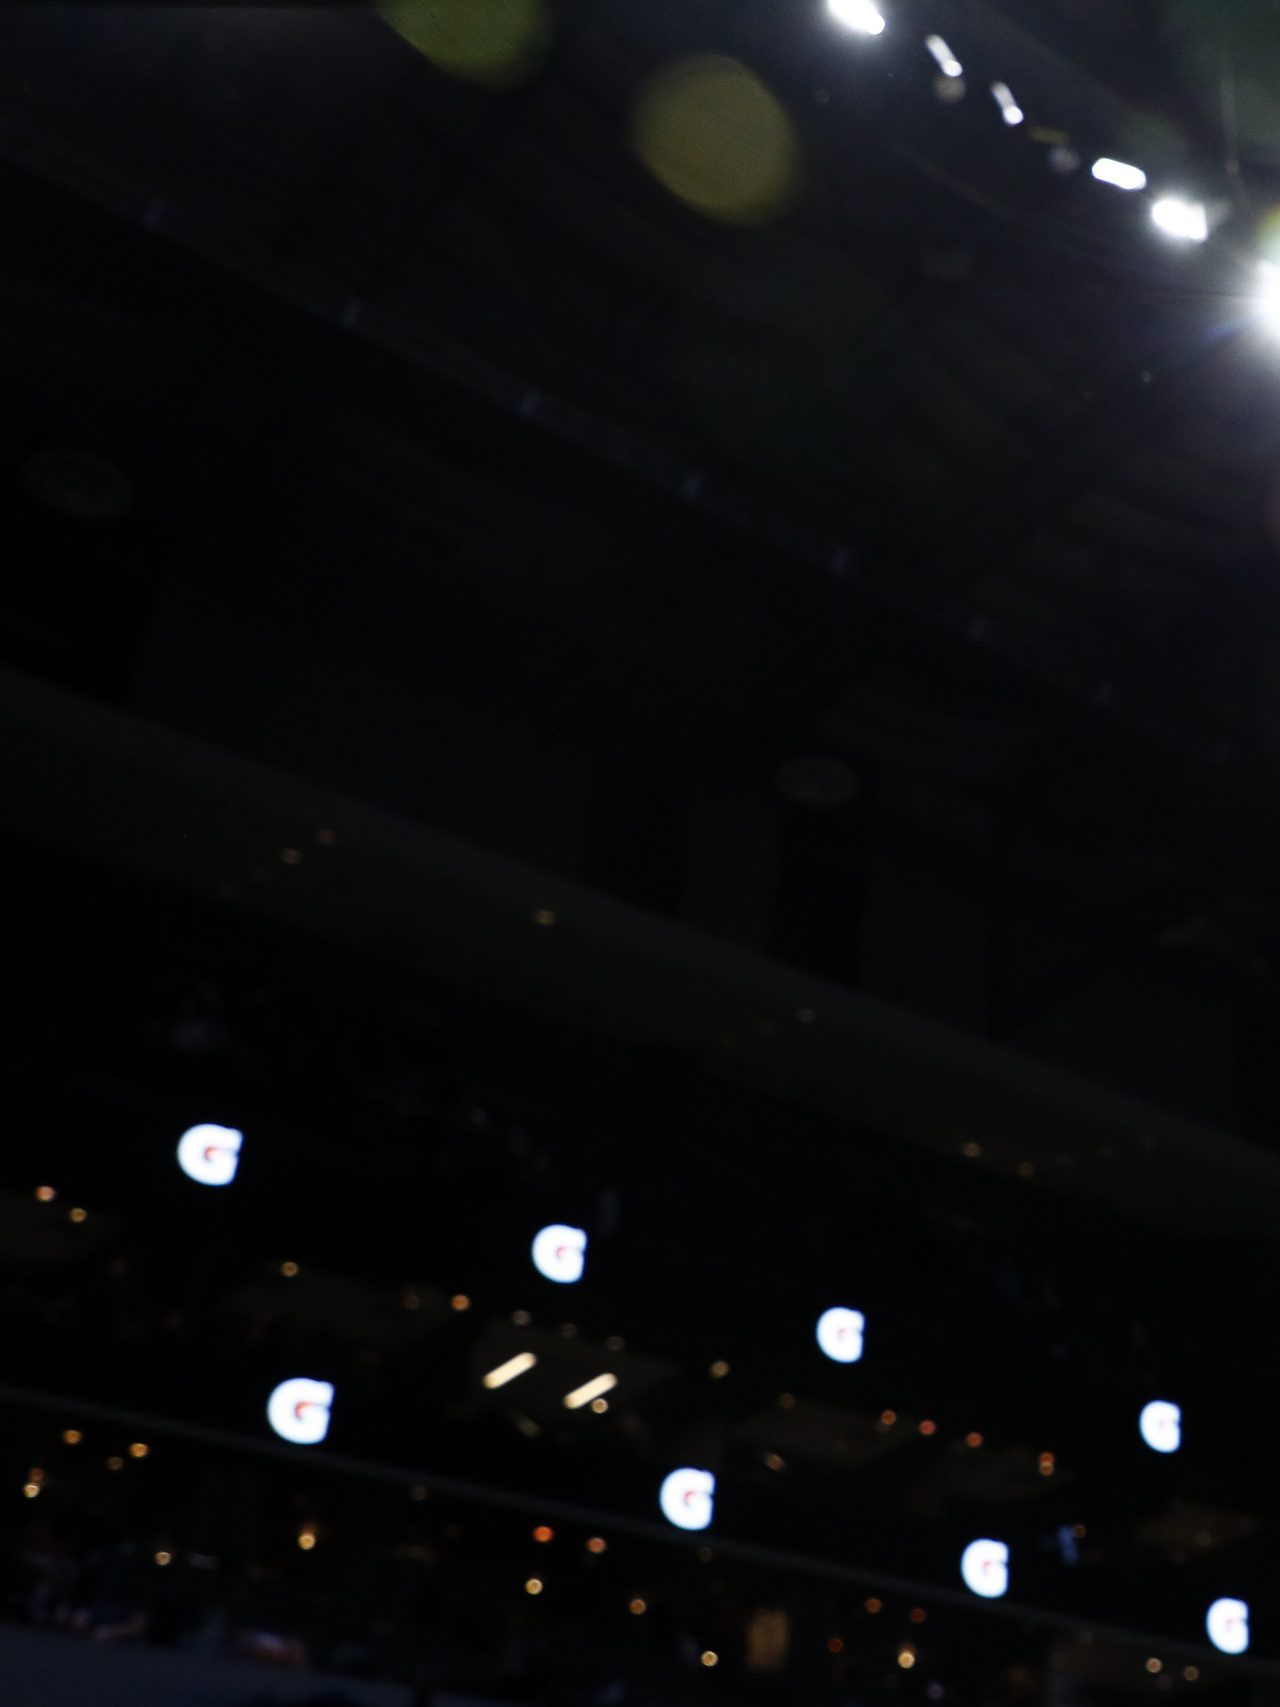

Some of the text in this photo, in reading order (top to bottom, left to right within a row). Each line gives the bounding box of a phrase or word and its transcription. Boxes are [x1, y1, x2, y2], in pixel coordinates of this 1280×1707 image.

[177, 1123, 243, 1186] G
[531, 1224, 587, 1283] G
[816, 1307, 865, 1363] G
[267, 1377, 334, 1444] G
[659, 1467, 715, 1531] G
